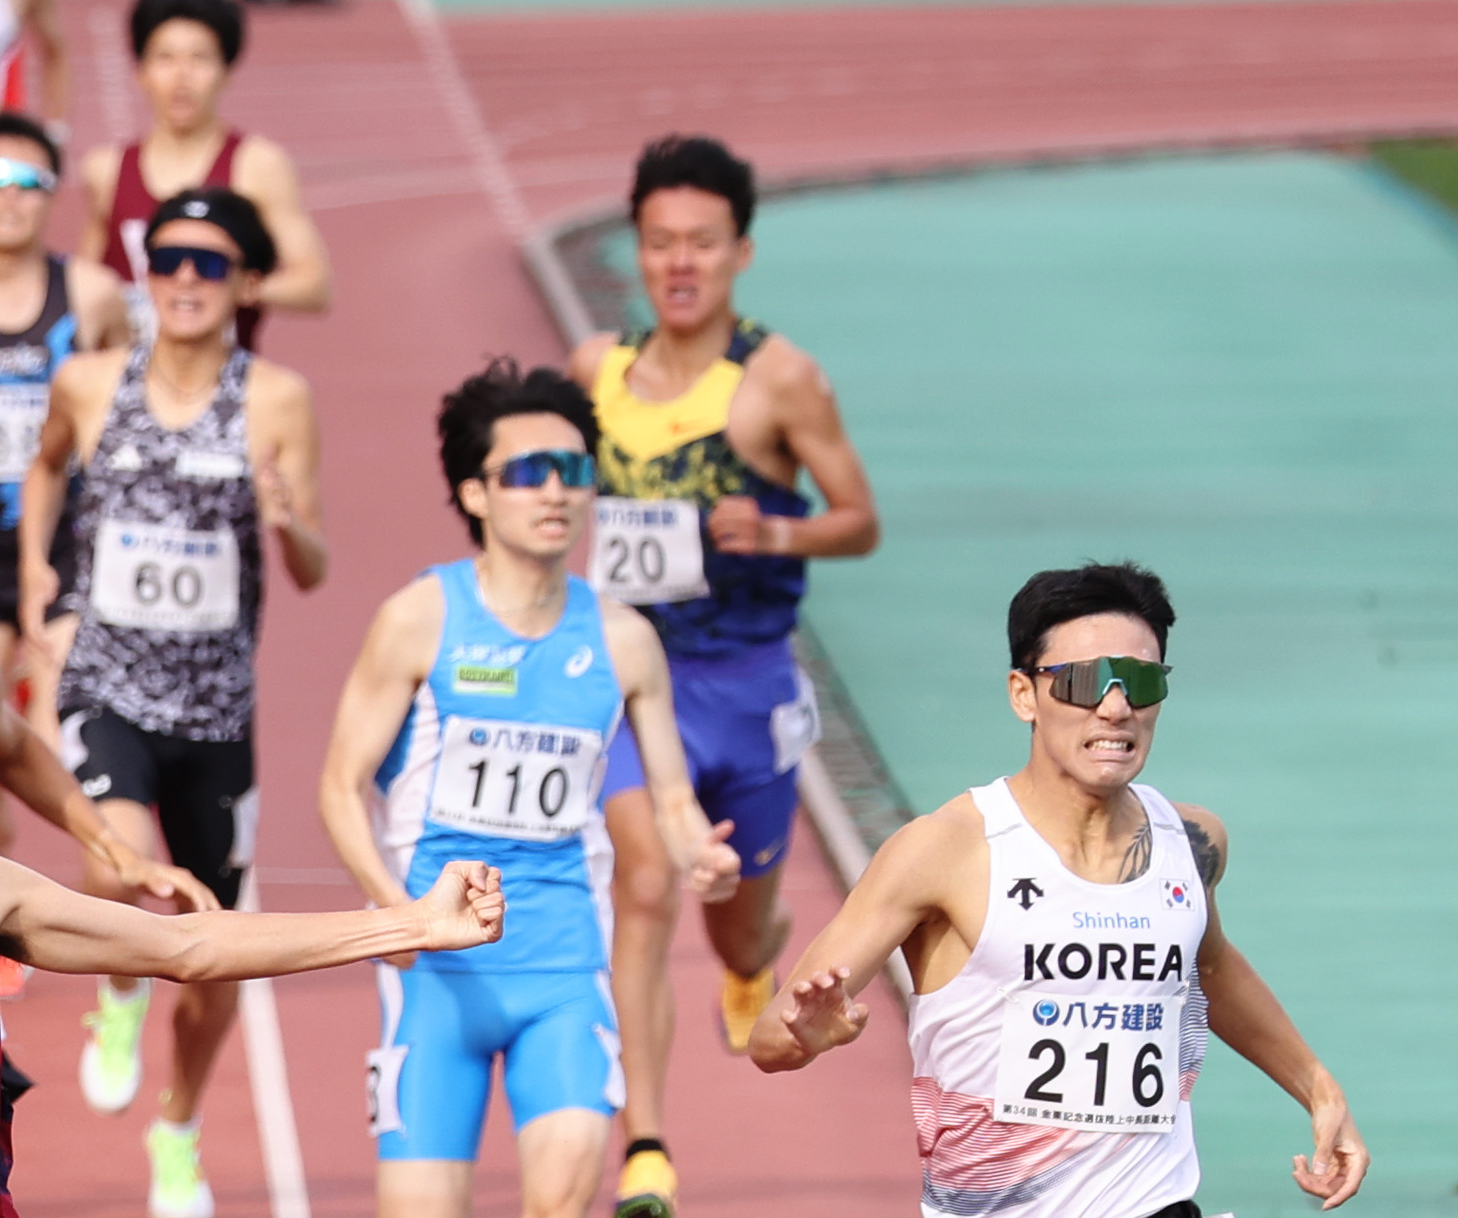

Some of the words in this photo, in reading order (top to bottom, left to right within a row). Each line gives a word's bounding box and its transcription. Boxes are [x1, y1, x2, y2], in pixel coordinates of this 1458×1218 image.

[609, 536, 665, 583] 20
[134, 562, 203, 609] 60
[468, 758, 569, 818] 110
[1073, 911, 1151, 929] Shinhan
[1023, 942, 1183, 982] KOREA
[1062, 1002, 1164, 1032] 八方建設
[1024, 1038, 1164, 1108] 216
